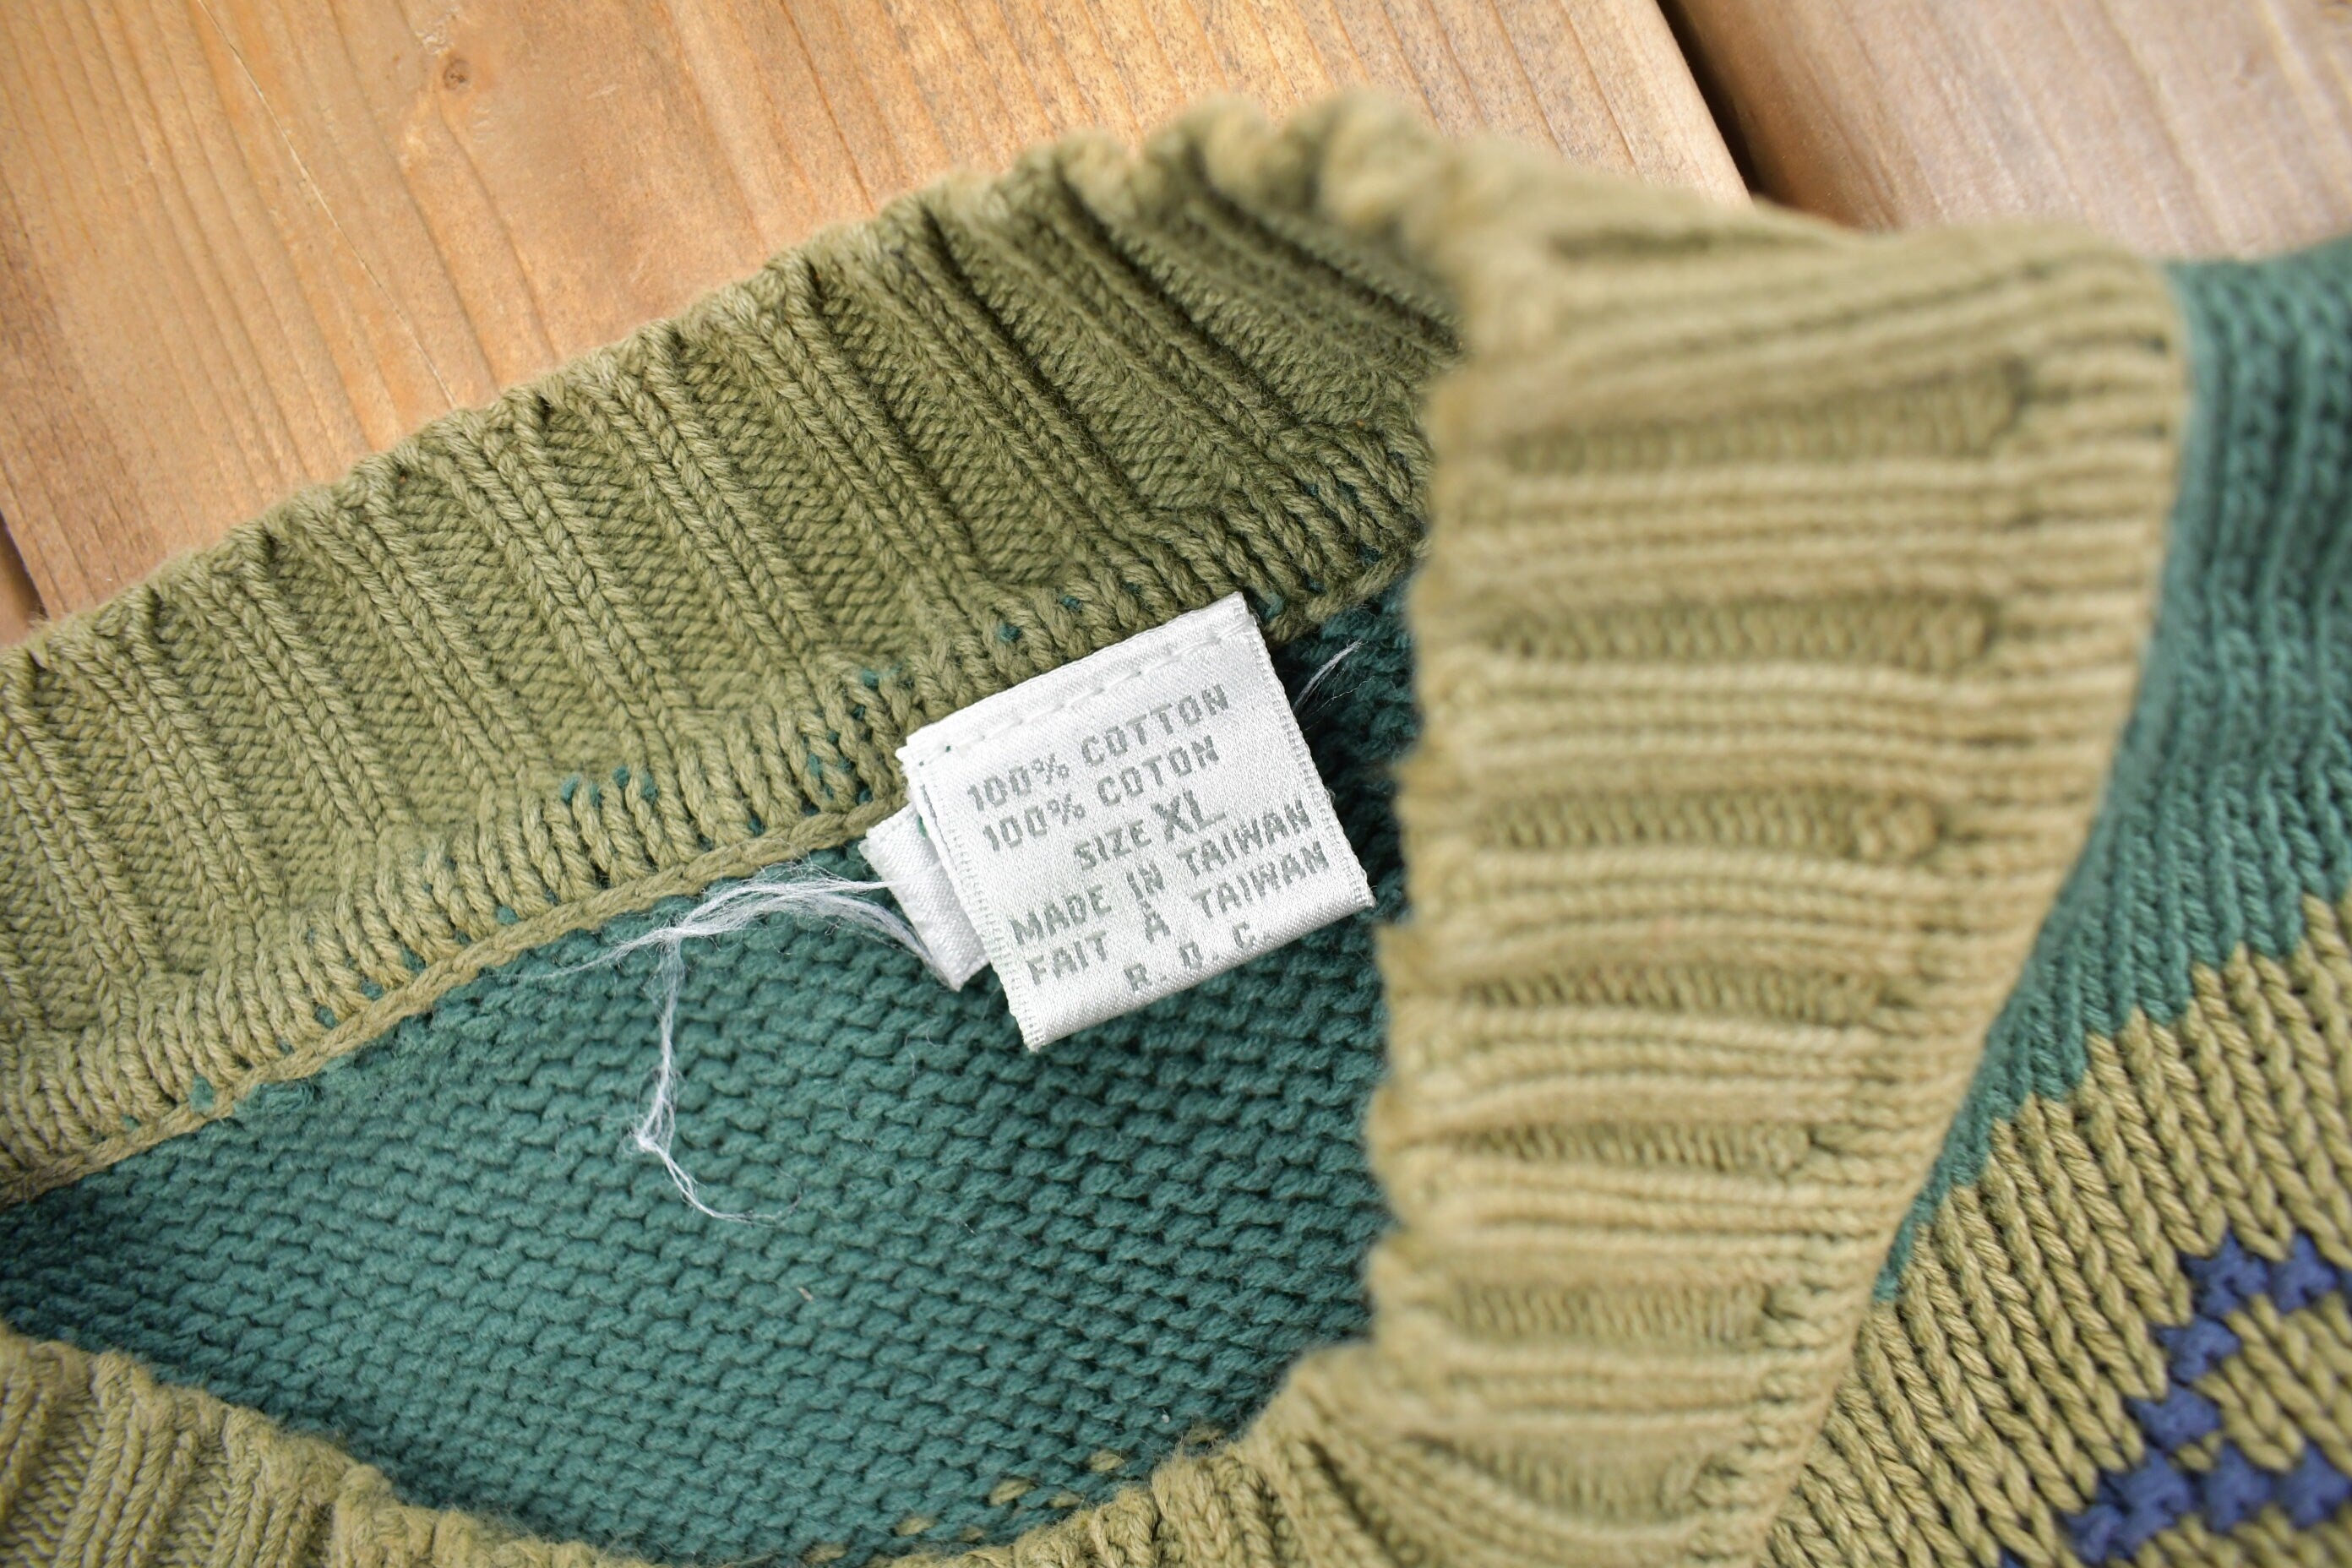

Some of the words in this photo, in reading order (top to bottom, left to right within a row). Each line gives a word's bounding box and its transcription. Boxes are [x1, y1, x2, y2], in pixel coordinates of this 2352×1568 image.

[967, 754, 1070, 812] 100%
[1081, 683, 1229, 766] COTTON
[983, 792, 1086, 852] 100%
[1097, 735, 1220, 807] COTON
[1010, 884, 1113, 946] MADE
[1127, 862, 1166, 901] IN
[1177, 800, 1312, 879] TAIWAN
[1074, 819, 1152, 871] SIZE
[1153, 788, 1225, 844] XL
[1027, 933, 1108, 987] FAIT
[1191, 841, 1329, 919] TAIWAN
